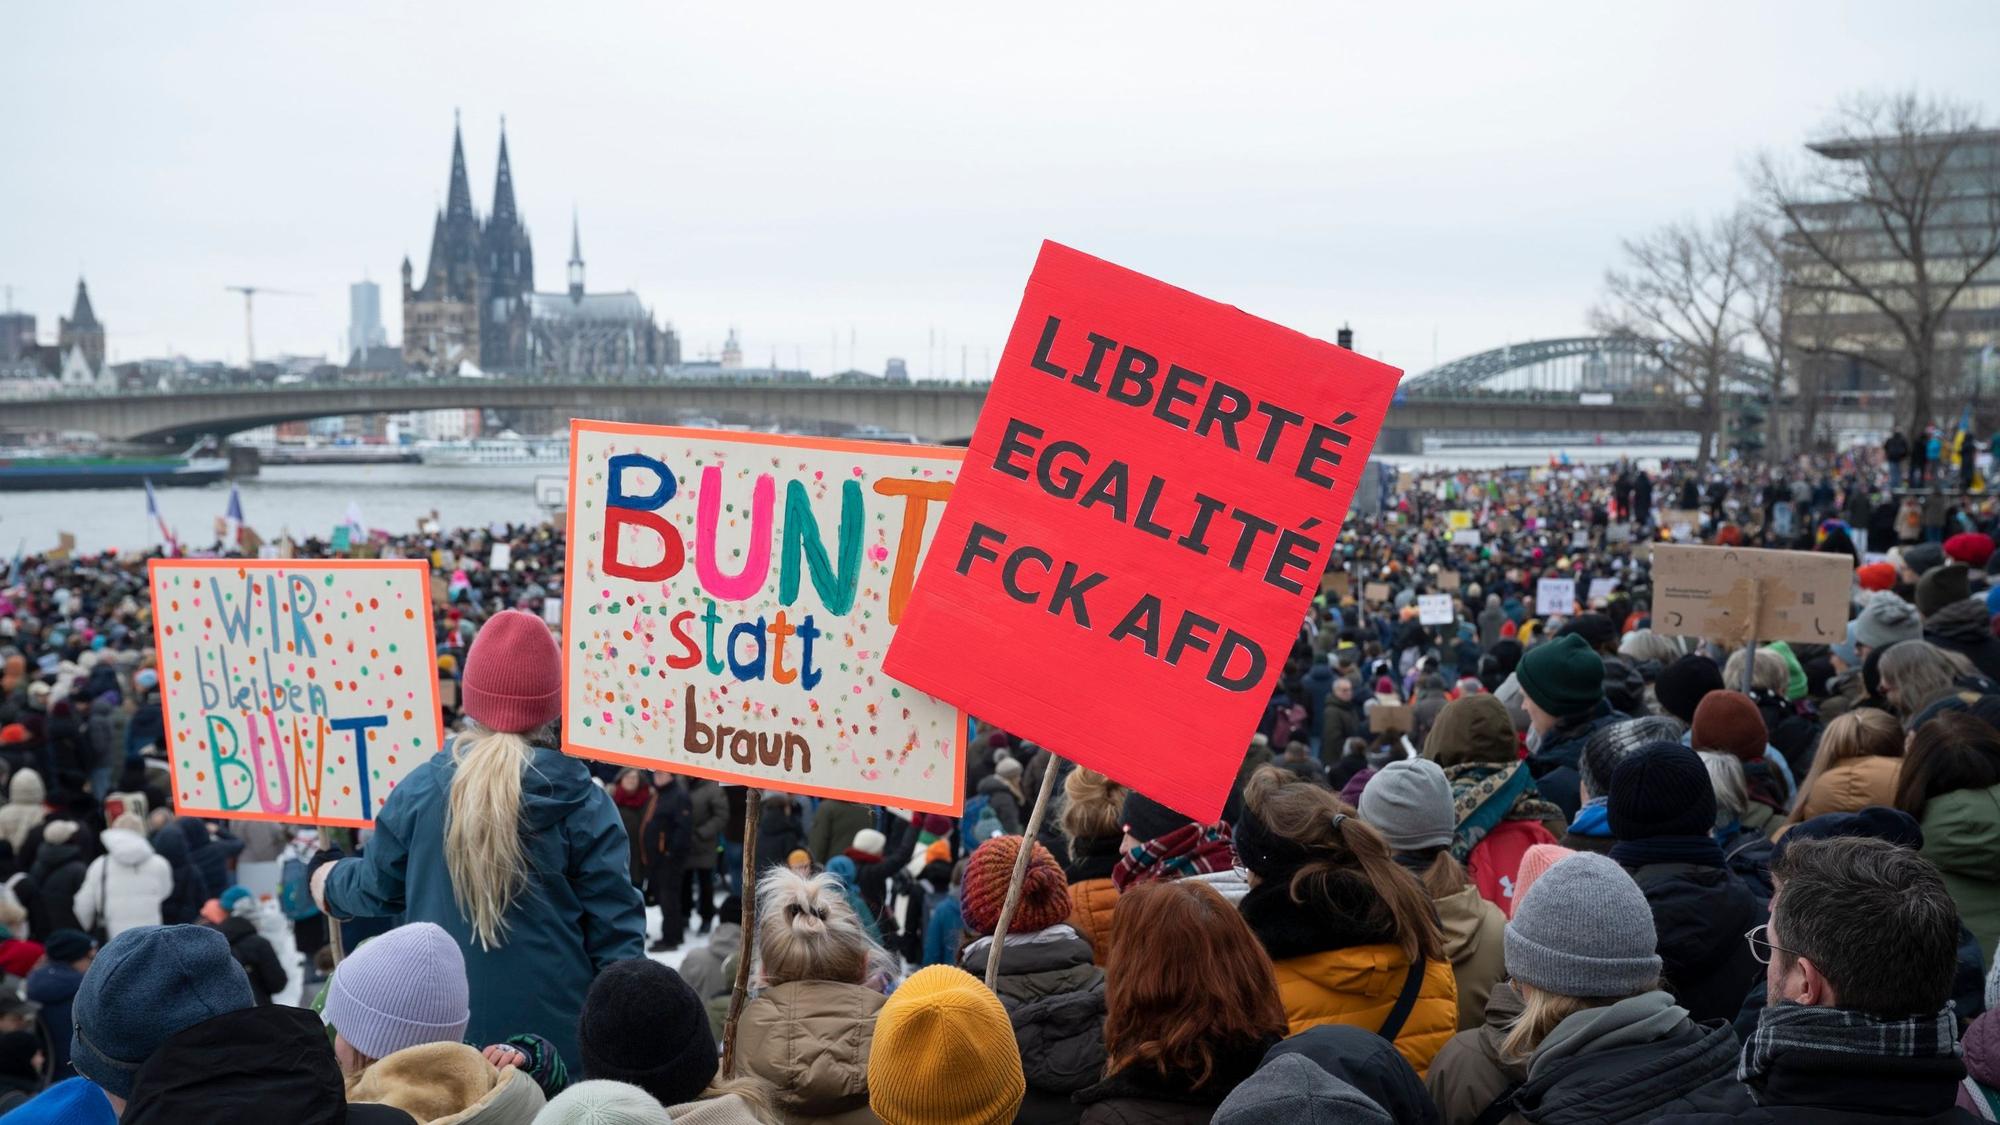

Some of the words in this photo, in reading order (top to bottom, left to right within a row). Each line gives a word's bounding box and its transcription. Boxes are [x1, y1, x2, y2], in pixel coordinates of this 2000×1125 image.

[1030, 315, 1358, 490] LIBERTÉ
[603, 453, 955, 625] BUNT
[992, 418, 1322, 595] EGALITÉ
[210, 574, 318, 658] WIR
[666, 602, 823, 690] statt
[955, 521, 1109, 630] FCK
[1108, 594, 1268, 692] AFD
[194, 645, 328, 715] bleiben
[684, 684, 812, 774] braun
[206, 713, 388, 820] BUNT
